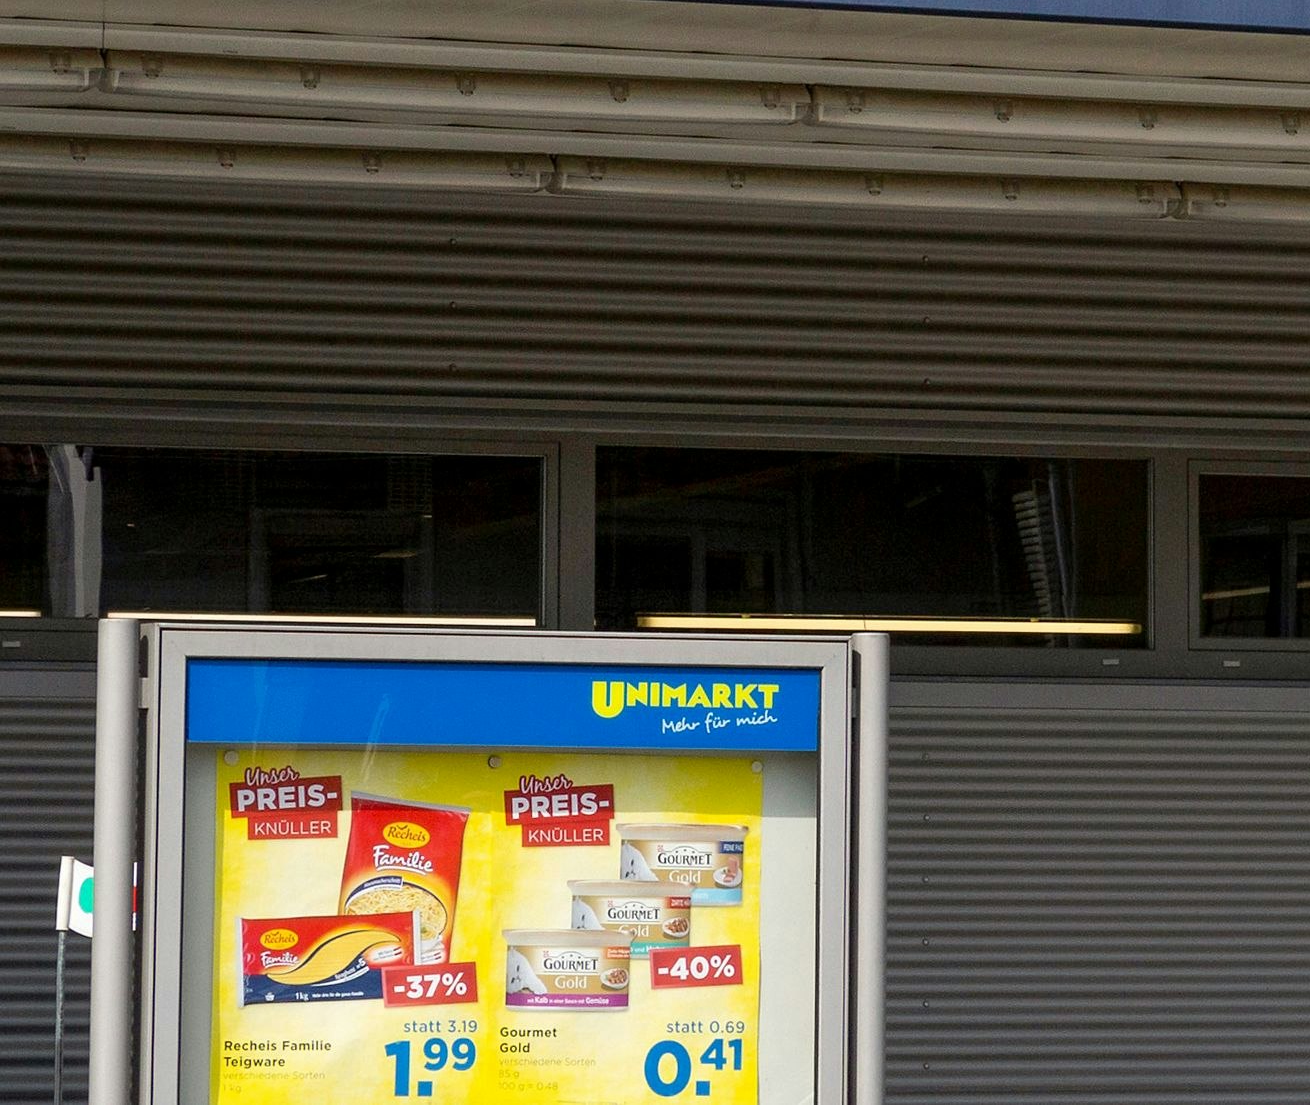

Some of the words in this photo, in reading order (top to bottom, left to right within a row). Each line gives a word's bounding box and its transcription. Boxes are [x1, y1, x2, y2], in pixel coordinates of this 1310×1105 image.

[592, 680, 780, 719] UNIMARKT
[661, 718, 700, 734] Mehr
[705, 711, 731, 734] für
[736, 710, 778, 727] mich
[245, 766, 300, 787] Unser
[519, 774, 573, 795] Unser
[236, 784, 338, 812] PREIS-
[511, 792, 610, 820] PREIS-
[253, 819, 332, 836] KNÜLLER
[387, 824, 427, 843] Recheis
[528, 826, 605, 844] KNÜLLER
[373, 844, 434, 873] Familie
[656, 852, 713, 866] GOURMET
[668, 869, 701, 882] Gold
[607, 907, 661, 922] GOURMET
[263, 930, 296, 946] Recheis
[260, 951, 300, 967] Familie
[543, 957, 599, 972] GOURMET
[657, 954, 735, 980] -40%
[393, 972, 468, 999] -37%
[554, 975, 587, 990] Gold
[403, 1021, 442, 1033] statt
[448, 1020, 478, 1033] 3.19
[499, 1027, 558, 1038] Gourmet
[666, 1021, 703, 1034] statt
[709, 1021, 745, 1034] 0.69
[223, 1040, 278, 1052] Recheis
[282, 1040, 332, 1052] Familie
[499, 1042, 531, 1053] Gold
[223, 1056, 286, 1069] Teigware
[384, 1037, 477, 1097] 1.99
[498, 1057, 562, 1067] verschiedene
[564, 1057, 596, 1067] Sorten
[644, 1038, 743, 1097] 0.41
[223, 1071, 290, 1080] verschiedene
[292, 1070, 326, 1080] Sorten
